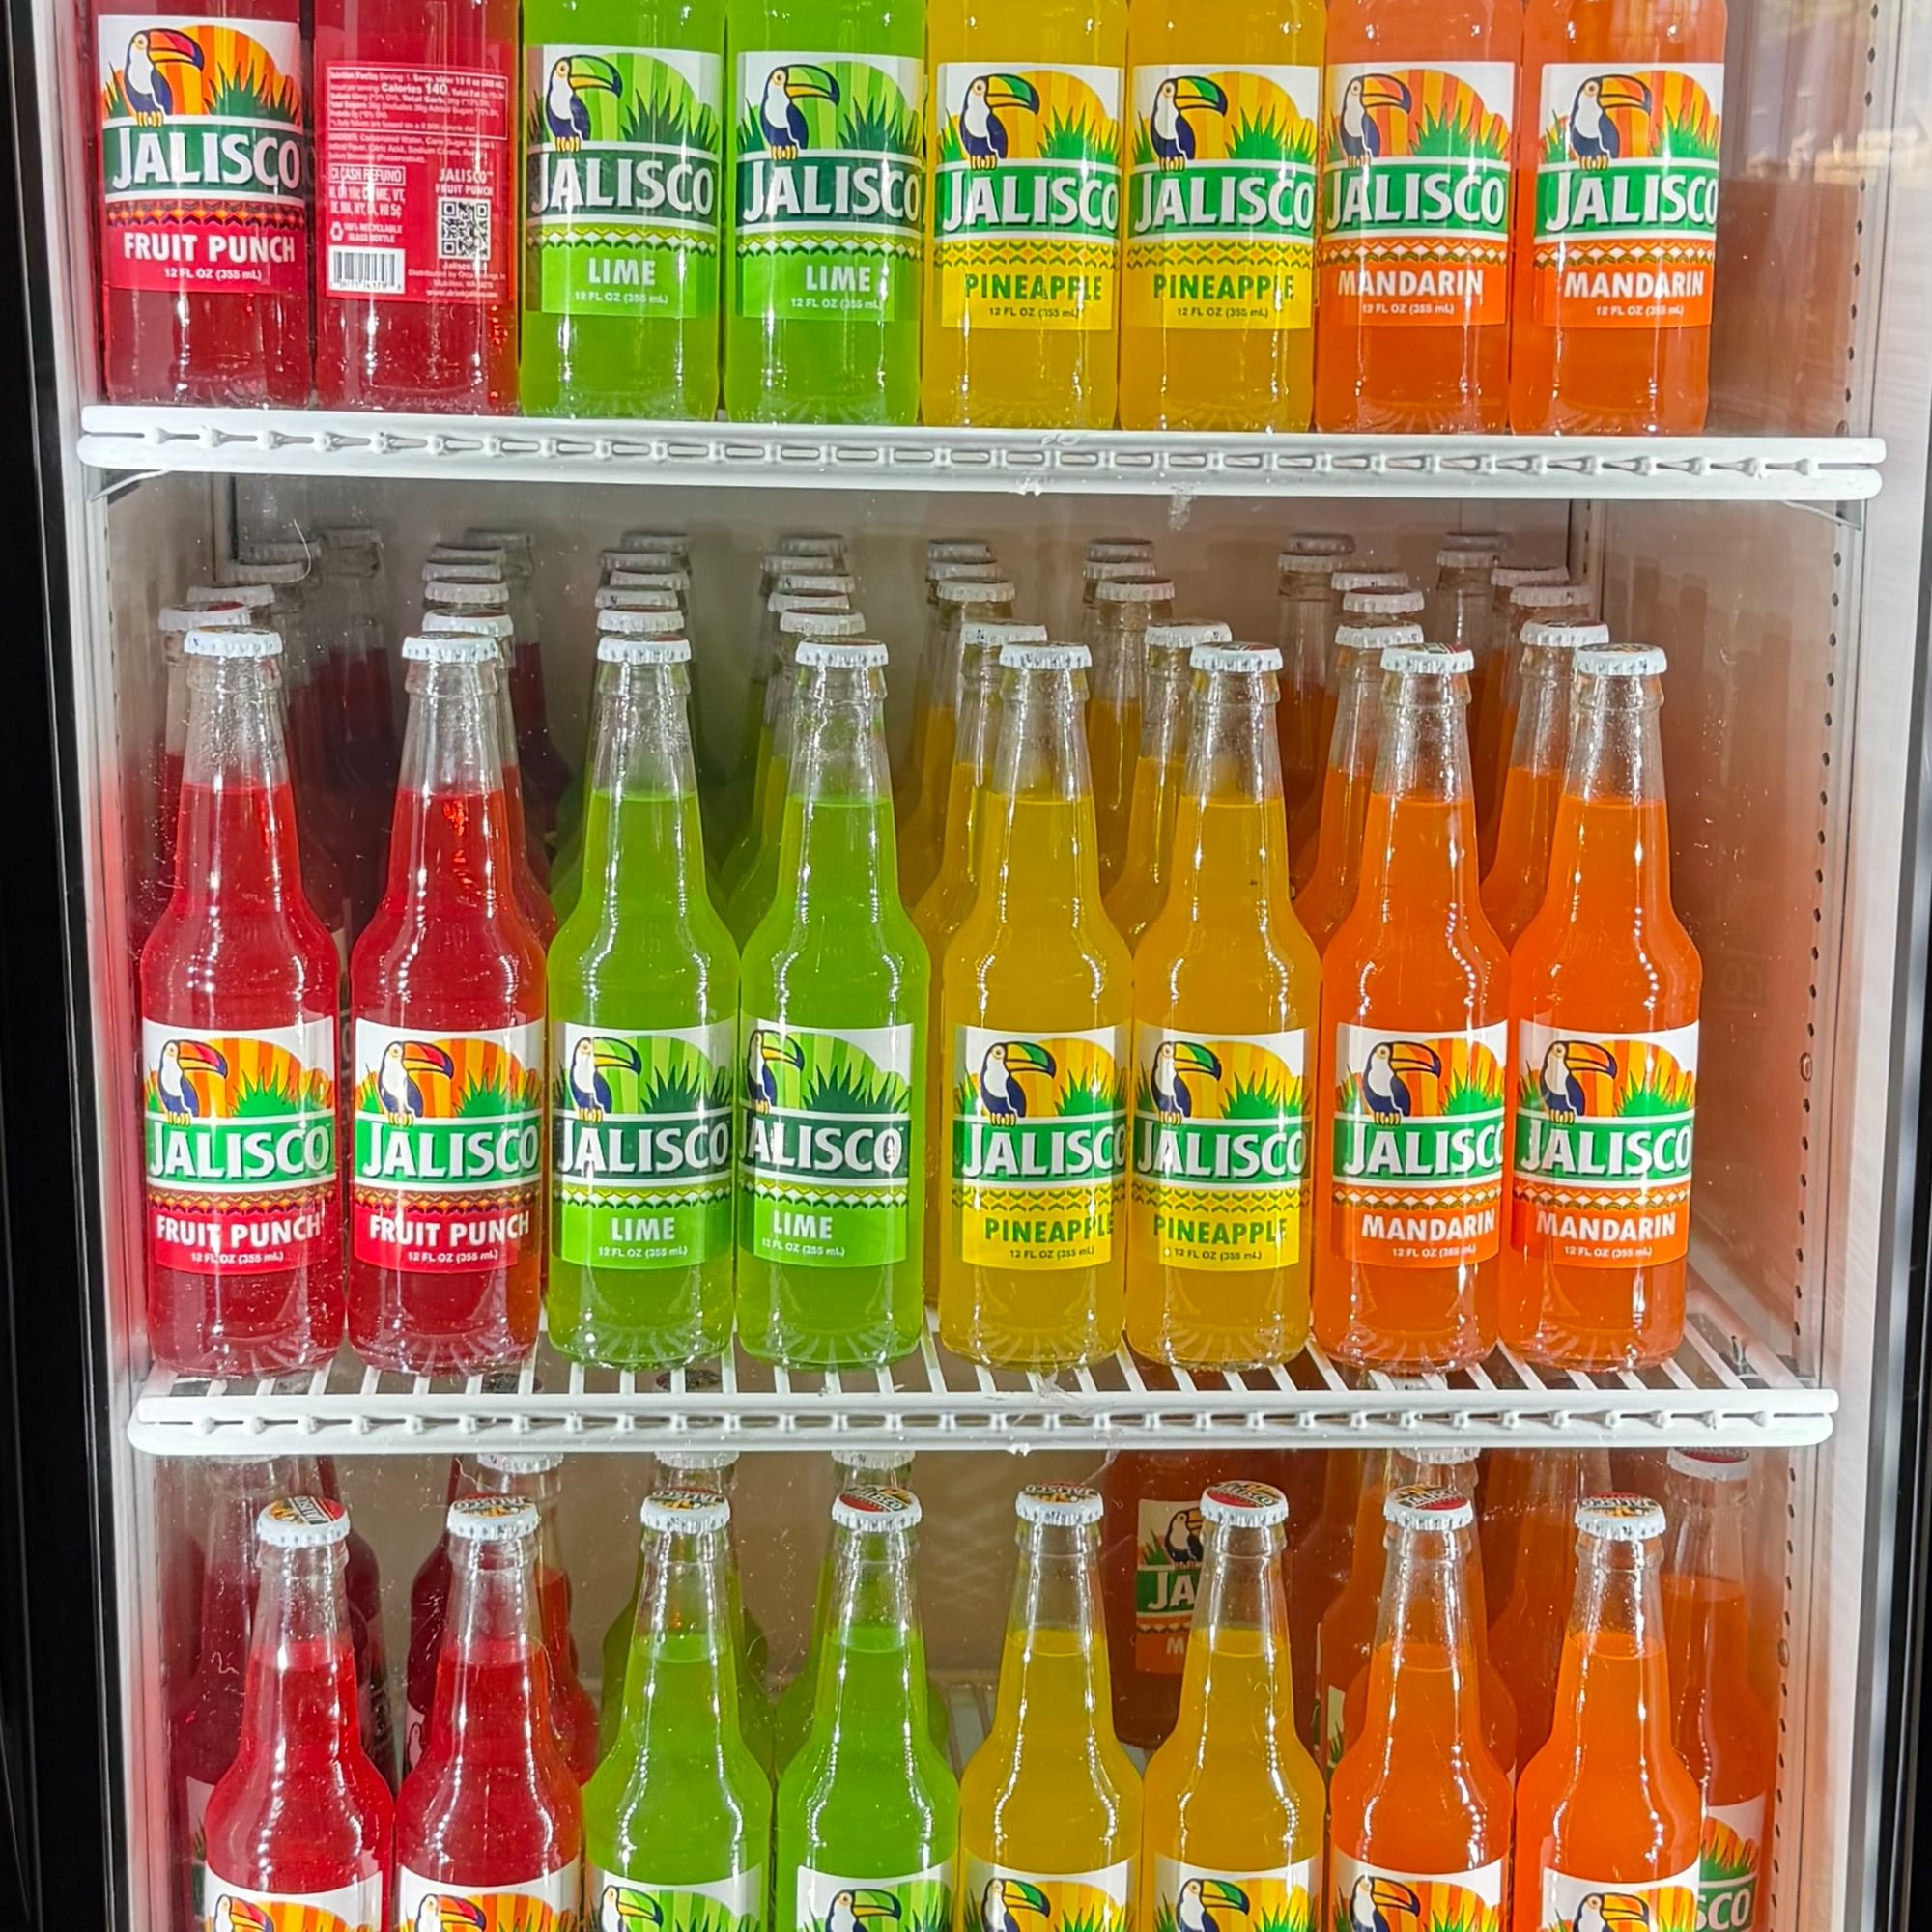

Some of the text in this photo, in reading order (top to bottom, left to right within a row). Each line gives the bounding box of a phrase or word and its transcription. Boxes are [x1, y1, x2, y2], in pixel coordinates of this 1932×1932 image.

[381, 82, 422, 94] Calories
[112, 128, 300, 189] JALISCO
[435, 184, 463, 194] FRUIT
[440, 168, 487, 184] JALISCO
[532, 153, 713, 215] JALISCO
[743, 161, 919, 221] JALISCO
[943, 171, 1119, 231] JALISCO
[1135, 173, 1314, 232] JALISCO
[1327, 171, 1504, 230] JALISCO
[1546, 172, 1718, 231] JALISCO
[124, 232, 294, 263] FRUIT PUNCH
[164, 268, 177, 278] 12
[179, 269, 193, 278] FL
[196, 270, 213, 279] OZ
[588, 258, 656, 286] LIME
[806, 265, 870, 292] LIME
[1338, 270, 1483, 296] MANDARIN
[1564, 270, 1704, 298] MANDARIN
[576, 291, 587, 300] 12
[589, 292, 602, 301] FL
[605, 292, 620, 302] OZ
[965, 274, 1101, 300] PINEAPPLE
[1153, 274, 1293, 299] PINEAPPLE
[792, 298, 804, 307] 12
[806, 299, 819, 308] FL
[822, 299, 838, 308] OZ
[1020, 308, 1034, 317] OZ
[1363, 304, 1374, 313] 12
[1376, 304, 1388, 313] FL
[1391, 304, 1406, 313] OZ
[1597, 306, 1607, 315] 12
[1611, 306, 1623, 315] FL
[1628, 306, 1642, 315] OZ
[150, 1122, 329, 1178] JALISCO
[362, 1122, 538, 1177] JALISCO
[557, 1120, 728, 1173] JALISCO
[962, 1123, 1125, 1177] JALISCO
[1138, 1122, 1306, 1177] JALISCO
[1521, 1119, 1691, 1174] JALISCO
[156, 1213, 320, 1248] FRUIT PUNCH
[370, 1211, 529, 1246] FRUIT PUNCH
[611, 1217, 675, 1241] LIME
[774, 1210, 833, 1240] LIME
[985, 1212, 1114, 1243] PINEAPPLE
[1153, 1214, 1287, 1244] PINEAPPLE
[1362, 1208, 1495, 1241] MANDARIN
[1536, 1210, 1676, 1241] MANDARIN
[192, 1253, 202, 1262] 12
[204, 1253, 218, 1262] FL
[220, 1254, 236, 1263] OZ
[408, 1252, 419, 1261] 12
[422, 1253, 435, 1262] FL
[439, 1253, 453, 1262] OZ
[599, 1246, 611, 1255] 12
[613, 1247, 623, 1257] FL
[628, 1248, 642, 1257] OZ
[762, 1238, 772, 1247] 12
[773, 1240, 782, 1250] FL
[786, 1242, 799, 1252] OZ
[1024, 1250, 1036, 1259] FL
[1188, 1250, 1199, 1259] FL
[1203, 1251, 1216, 1260] OZ
[1406, 1248, 1419, 1257] FL
[1422, 1248, 1436, 1257] OZ
[1565, 1246, 1576, 1255] 12
[1578, 1247, 1591, 1256] FL
[1594, 1248, 1608, 1257] OZ
